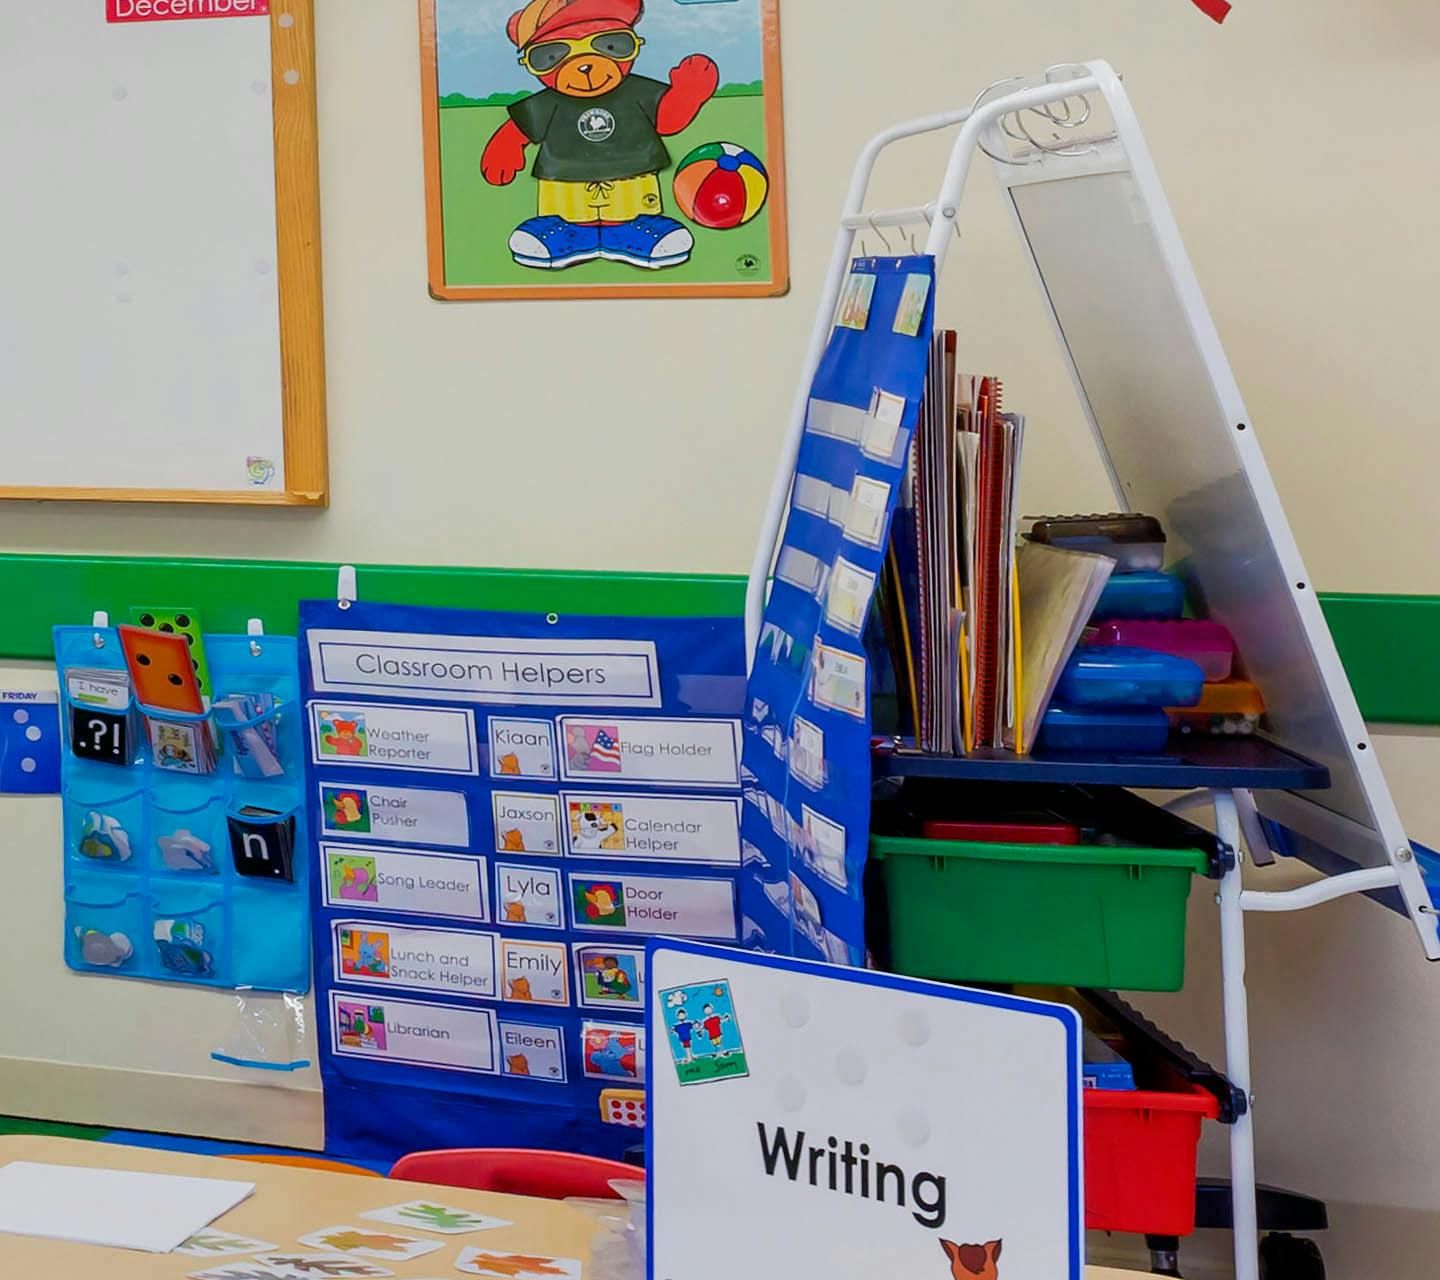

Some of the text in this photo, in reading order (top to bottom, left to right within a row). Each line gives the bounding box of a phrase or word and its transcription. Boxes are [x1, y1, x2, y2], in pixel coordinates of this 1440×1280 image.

[356, 653, 606, 684] Classroom Helpers
[2, 691, 37, 700] FRIDAY
[89, 682, 119, 696] have
[366, 727, 430, 745] Weather
[495, 728, 551, 746] Kiaan
[368, 743, 432, 761] Reporter
[619, 741, 712, 759] Flag Holder
[369, 794, 407, 810] Chair
[371, 812, 418, 828] Pusher
[498, 805, 553, 821] Jaxson
[624, 818, 702, 834] Calendar
[626, 836, 679, 853] Helper
[377, 873, 471, 892] Song Leader
[506, 875, 551, 898] Lyla
[625, 887, 663, 901] Door
[626, 906, 679, 921] Holder
[390, 948, 469, 967] Lunch and
[506, 951, 562, 976] Emily
[391, 966, 488, 989] Snack Helper
[386, 1022, 451, 1041] Librarian
[504, 1030, 556, 1049] Eileen
[757, 1121, 947, 1228] Writing
